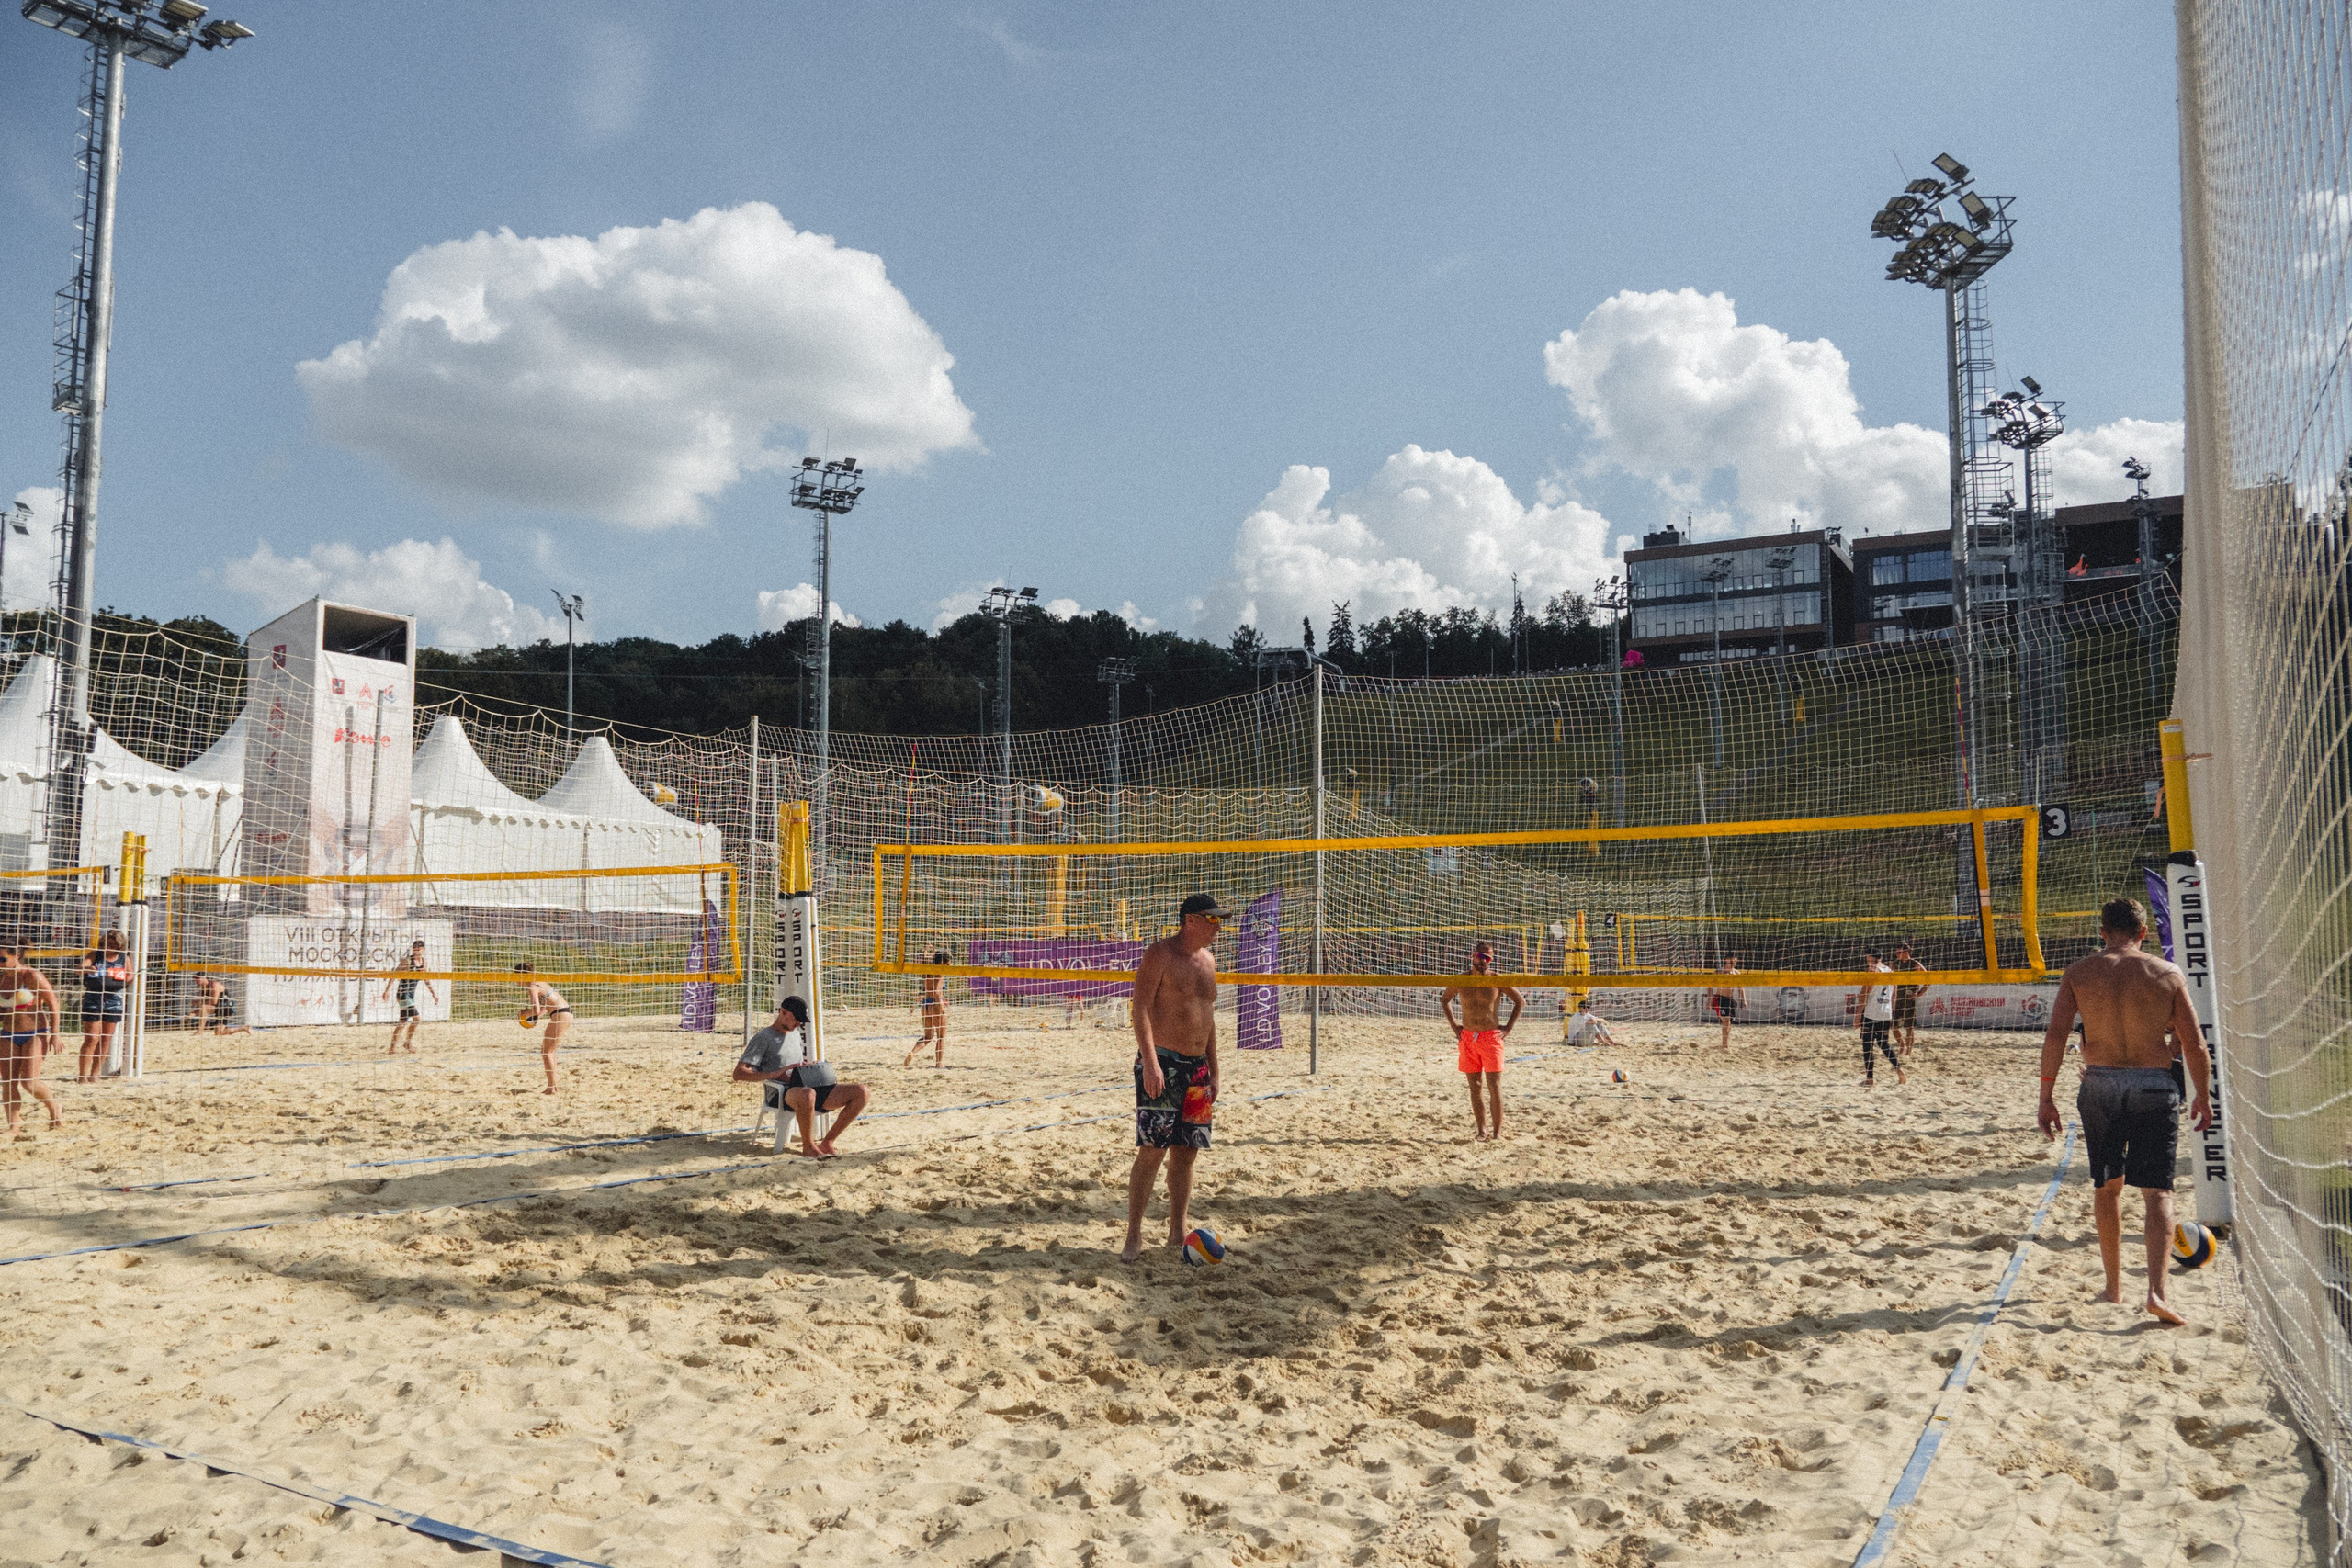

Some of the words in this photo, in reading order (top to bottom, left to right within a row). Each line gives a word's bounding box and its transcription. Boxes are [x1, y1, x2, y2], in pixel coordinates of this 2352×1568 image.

[2046, 808, 2067, 836] 3
[1607, 916, 1615, 927] 4
[2181, 893, 2209, 988] SPORT
[289, 946, 413, 964] МОСКОСКИ
[685, 942, 704, 1001] VOLEY
[792, 920, 803, 984] SPORT
[1257, 943, 1272, 1015] VOEY
[1257, 1018, 1272, 1042] LD
